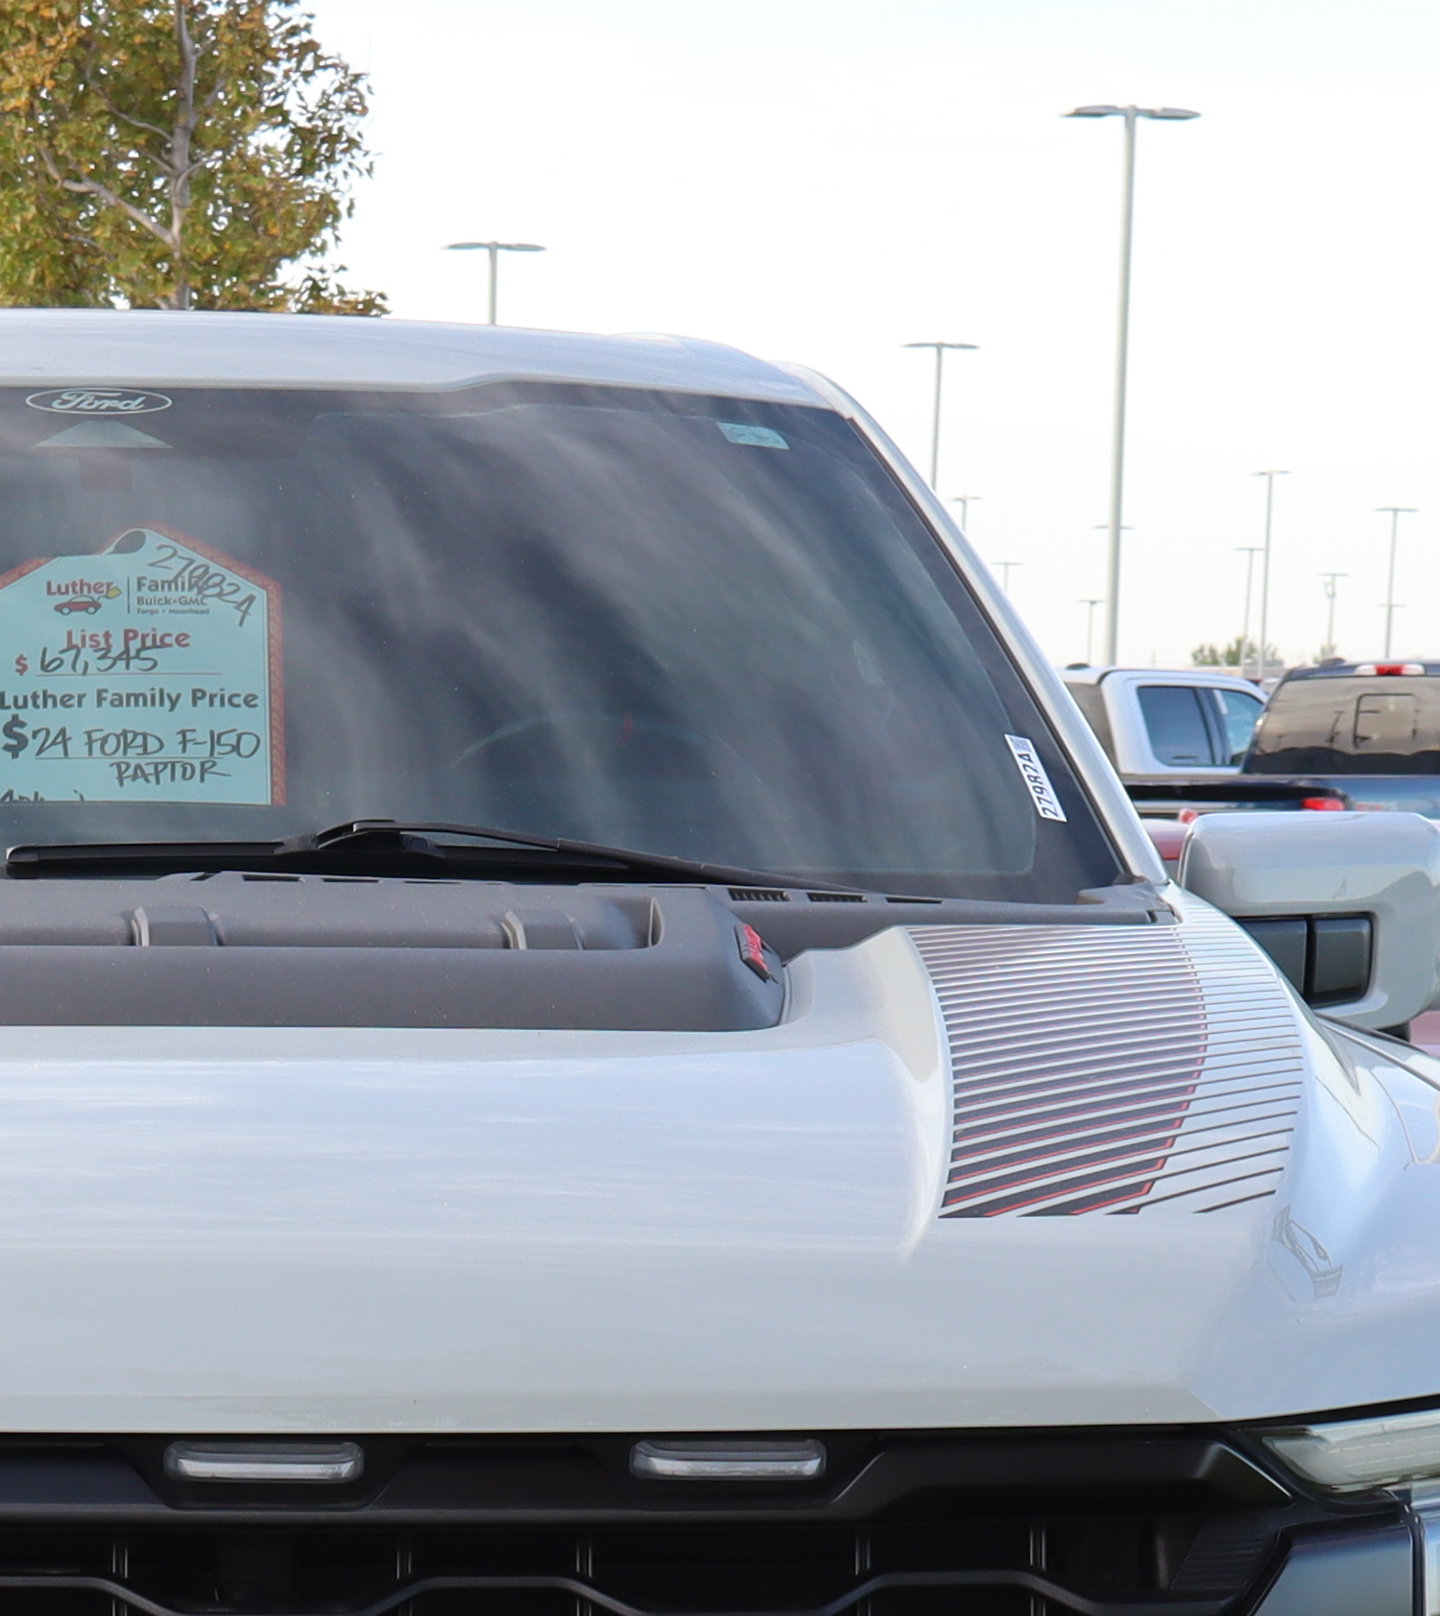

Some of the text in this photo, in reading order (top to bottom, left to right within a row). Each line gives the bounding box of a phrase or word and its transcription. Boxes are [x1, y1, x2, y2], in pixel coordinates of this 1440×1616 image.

[51, 390, 146, 410] Ford
[46, 578, 114, 596] Luther
[66, 628, 191, 649] List Price
[15, 645, 167, 676] $ 67,345
[0, 687, 259, 712] Luther Family Price
[83, 728, 165, 757] FORD
[176, 728, 261, 758] F-150
[109, 760, 231, 787] RAPTOR
[1017, 753, 1059, 818] 27982A
